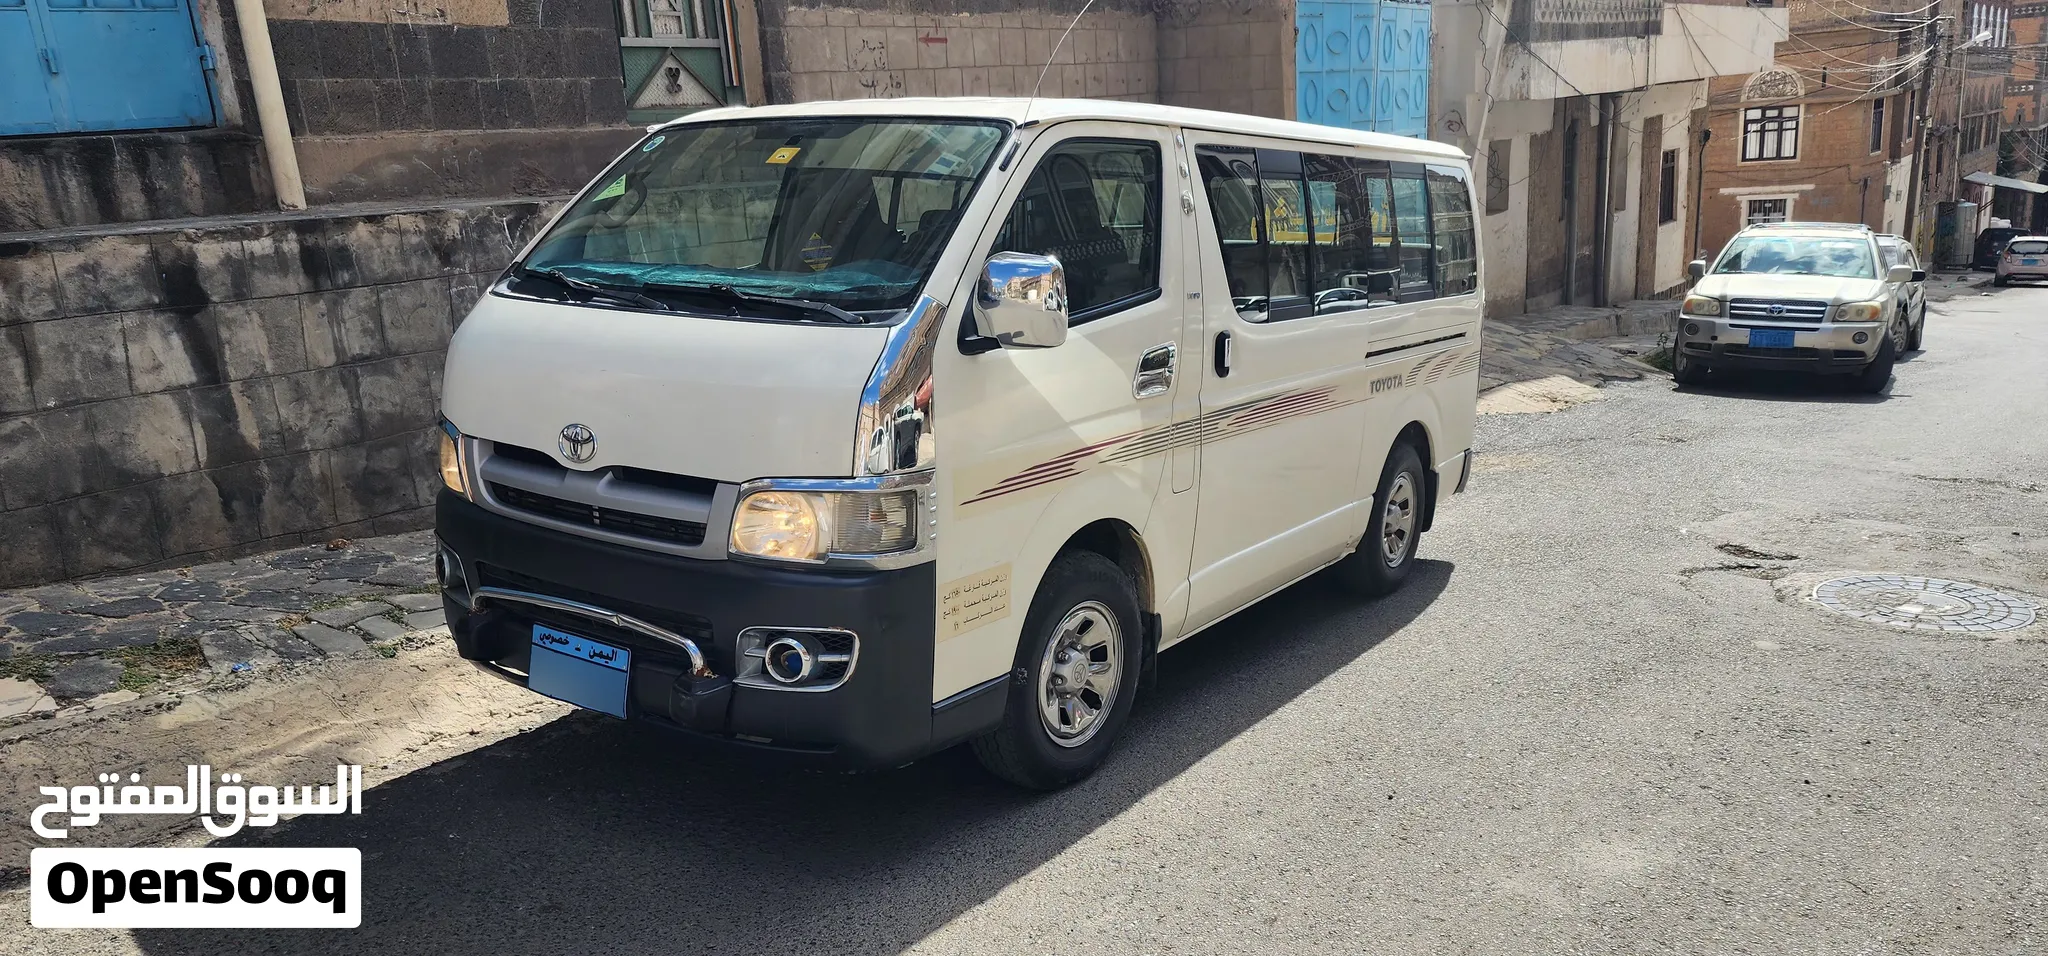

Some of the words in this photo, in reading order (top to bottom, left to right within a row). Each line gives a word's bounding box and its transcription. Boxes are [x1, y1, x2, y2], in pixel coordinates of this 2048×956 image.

[1370, 374, 1403, 394] TOYOTA
[539, 631, 570, 646] خصوصي
[588, 645, 618, 664] اليمن
